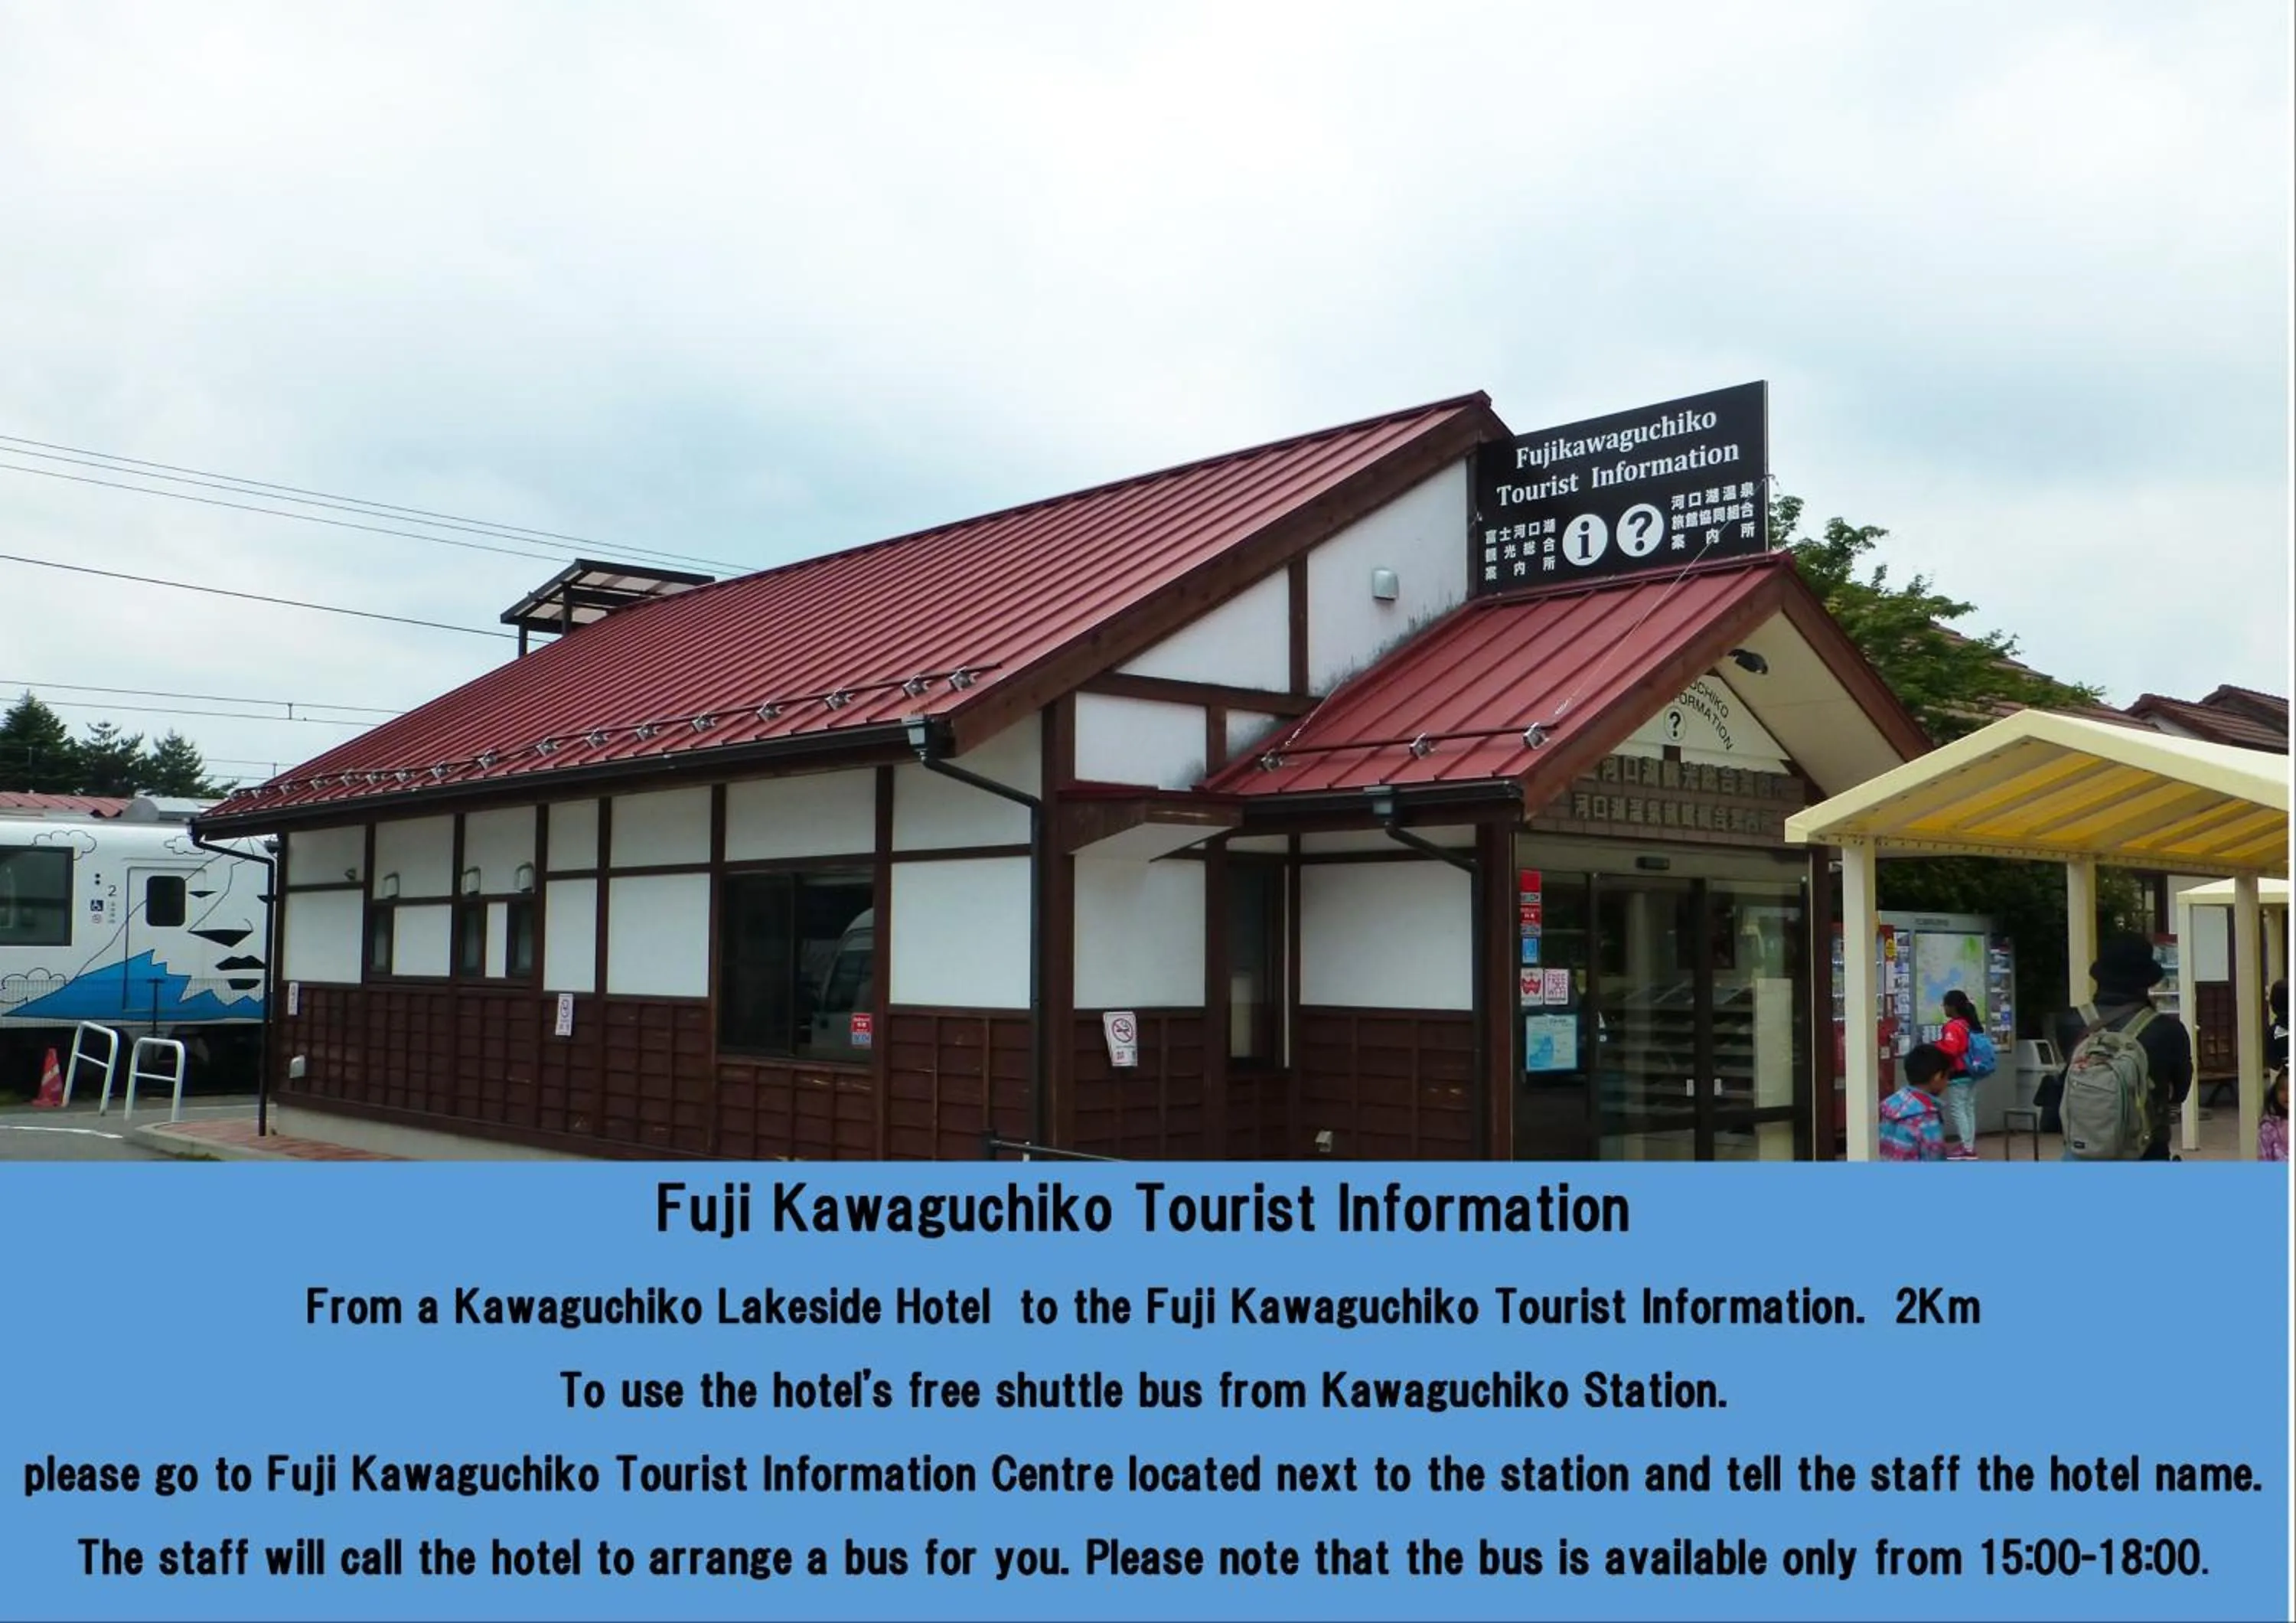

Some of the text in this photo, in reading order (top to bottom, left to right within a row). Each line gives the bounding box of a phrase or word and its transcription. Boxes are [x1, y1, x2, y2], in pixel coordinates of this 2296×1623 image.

[1515, 410, 1717, 469] Fujikawaguchiko
[1497, 443, 1740, 507] Tourist Information
[1671, 482, 1754, 511] 河口湖温泉
[1671, 521, 1755, 550] 案内所
[1673, 691, 1734, 750] ORMATION
[108, 884, 117, 896] 2
